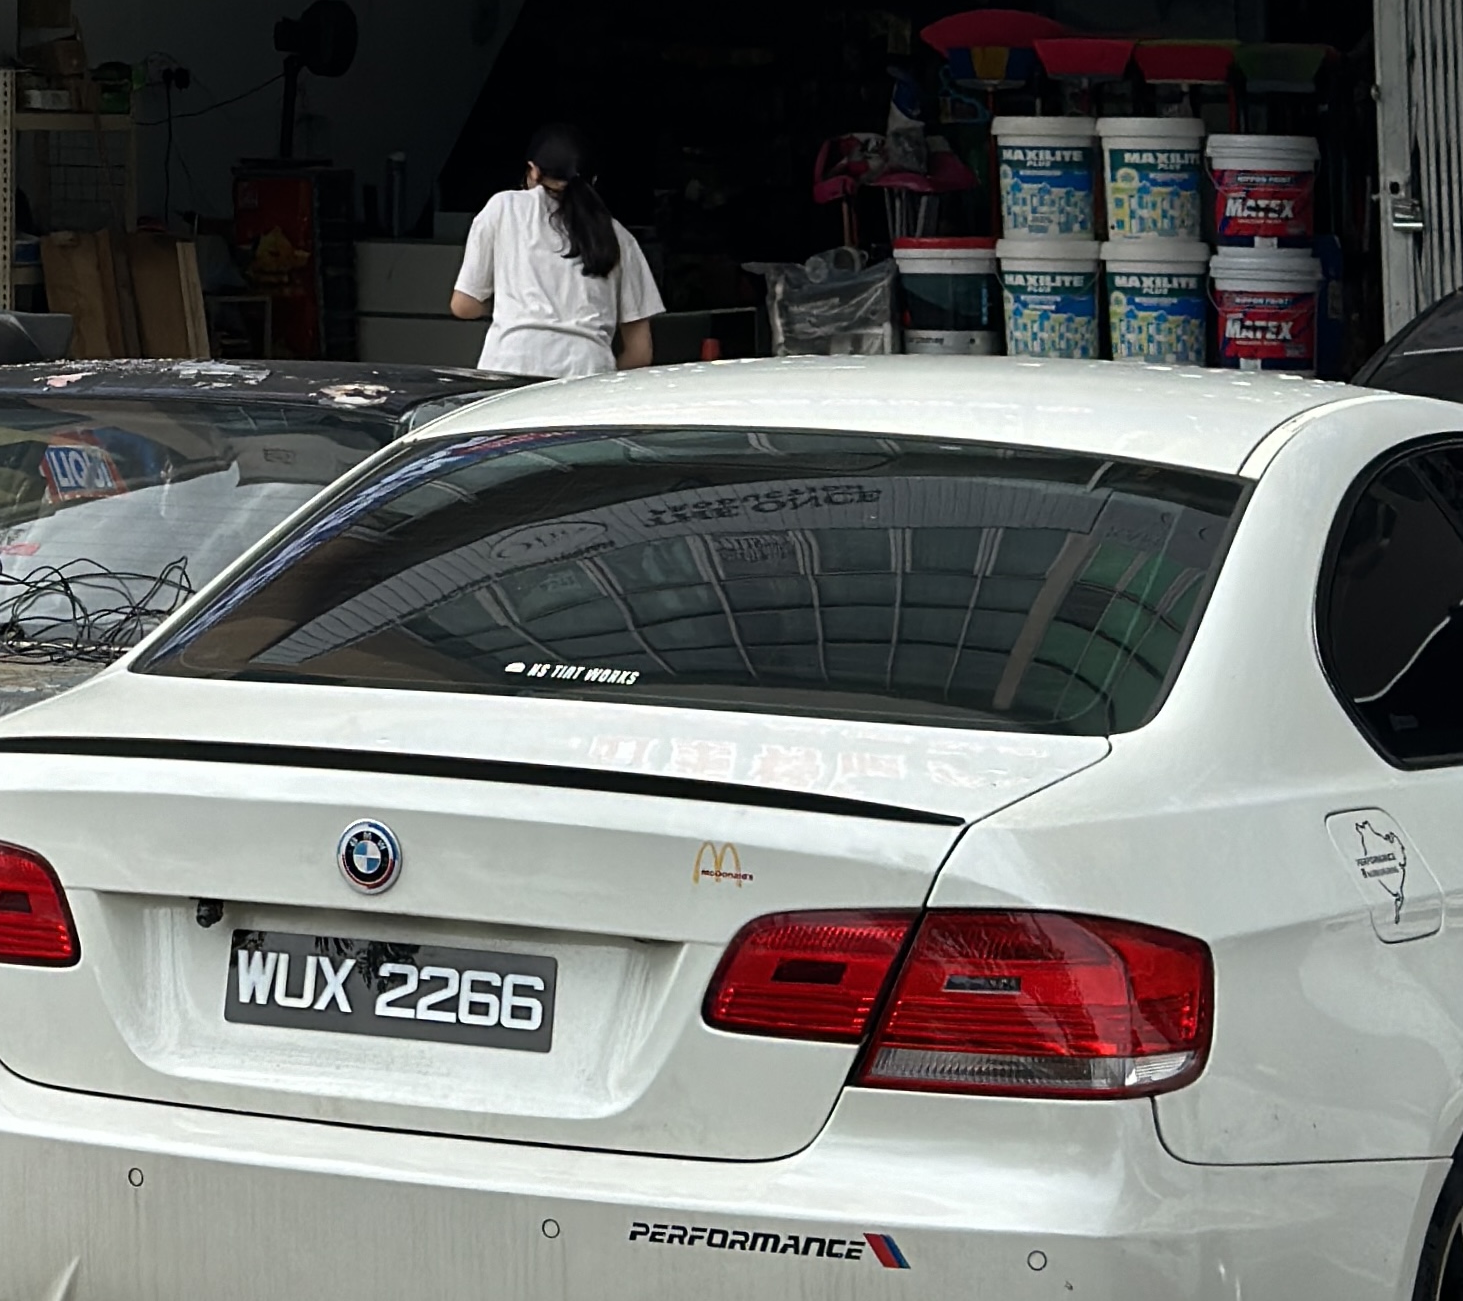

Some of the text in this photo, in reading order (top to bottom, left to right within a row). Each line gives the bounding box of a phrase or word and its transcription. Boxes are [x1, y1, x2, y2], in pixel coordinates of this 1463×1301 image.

[1001, 149, 1084, 163] MAXILITE
[1226, 198, 1294, 219] MATEX
[1003, 274, 1085, 288] MAXILITE
[1114, 275, 1199, 290] MAXILITE
[1226, 319, 1294, 341] MATEX
[551, 664, 586, 681] TINT
[584, 667, 641, 686] WORKS
[238, 949, 545, 1031] WUX 2266
[629, 1222, 866, 1260] PERFORMANCE
